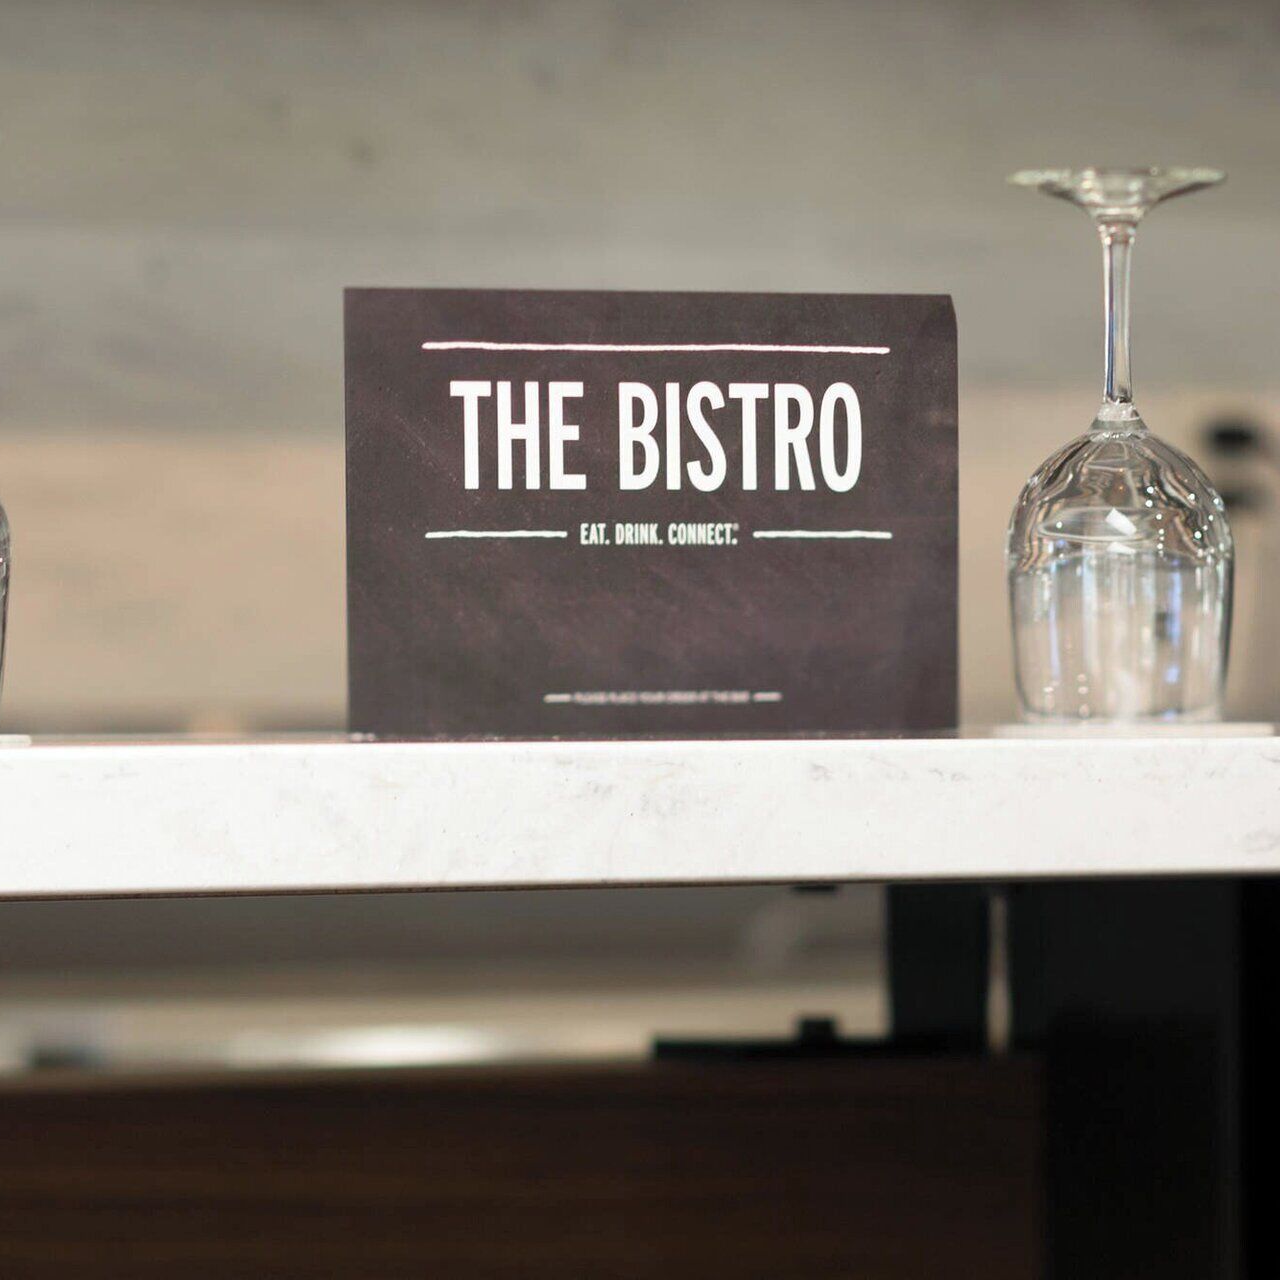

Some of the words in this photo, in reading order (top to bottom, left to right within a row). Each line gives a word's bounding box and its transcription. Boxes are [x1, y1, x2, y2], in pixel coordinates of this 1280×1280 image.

[449, 381, 587, 490] THE
[618, 381, 862, 493] BISTRO
[580, 523, 610, 545] EAT.
[615, 523, 663, 545] DRINK.
